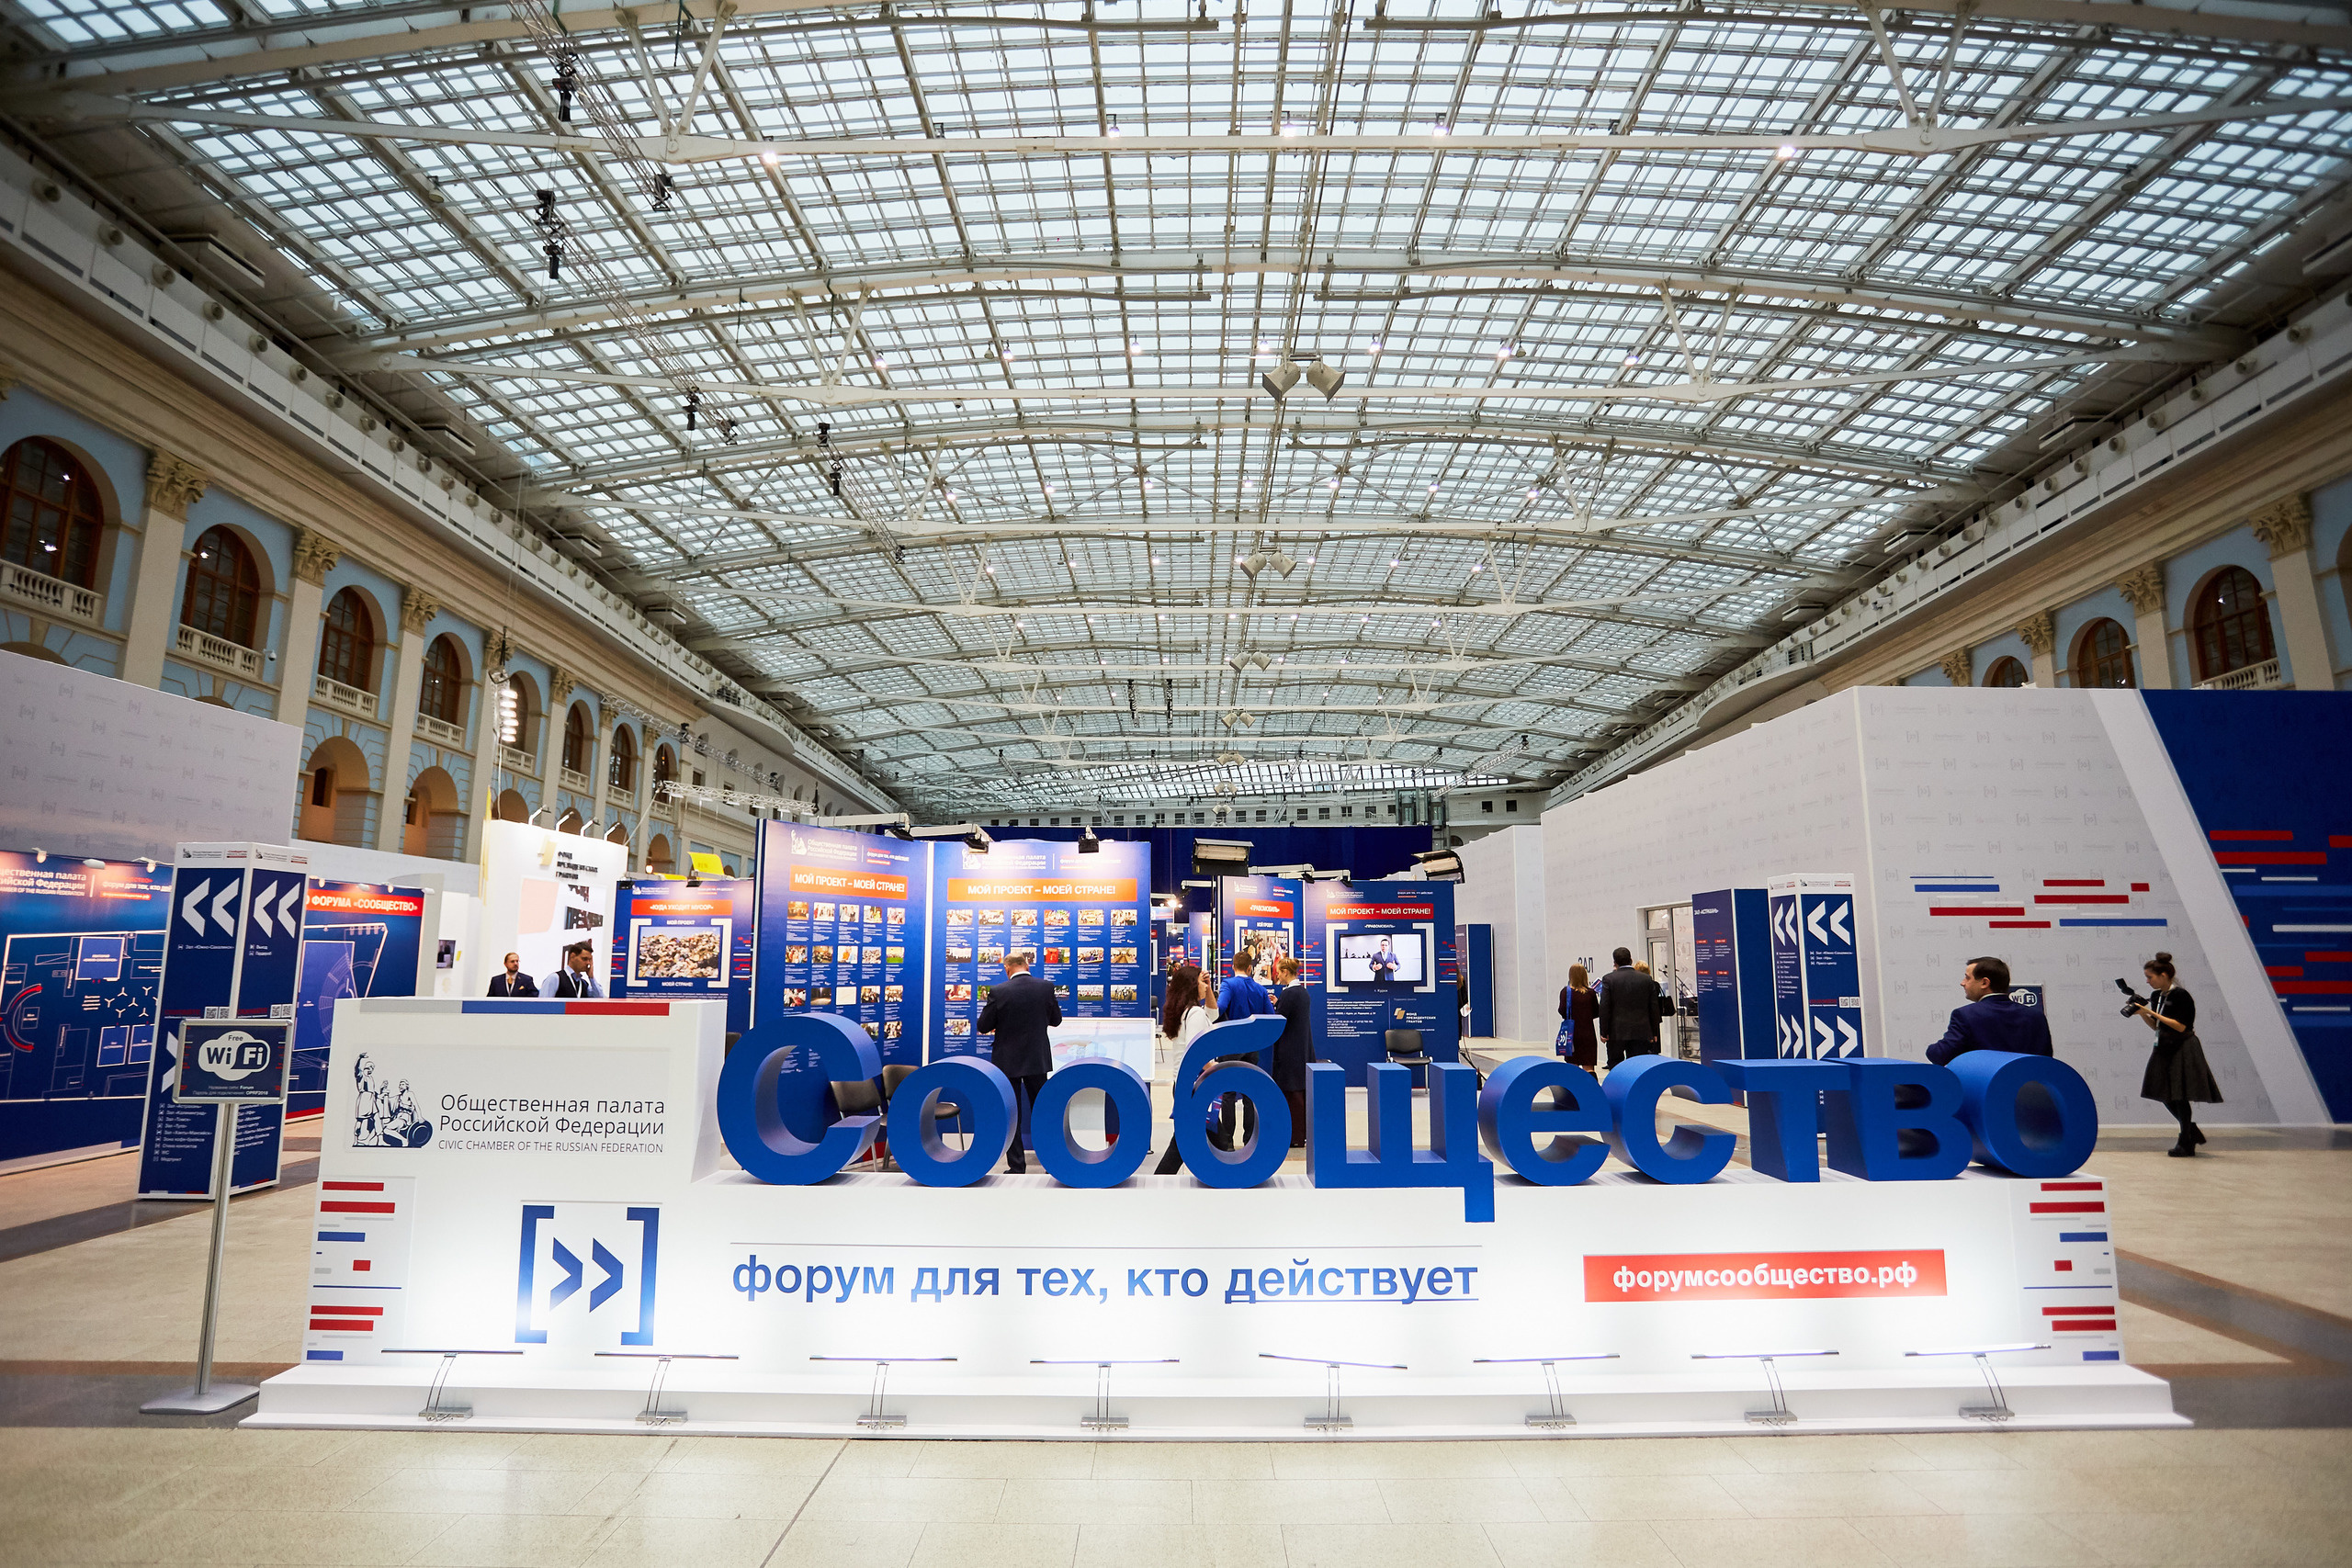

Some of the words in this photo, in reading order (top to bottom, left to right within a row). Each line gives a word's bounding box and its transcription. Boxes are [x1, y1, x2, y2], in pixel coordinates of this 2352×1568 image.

[36, 878, 85, 890] Федерации
[55, 873, 86, 881] палата
[795, 873, 814, 885] МОЙ
[816, 875, 847, 887] ПРОЕКТ
[854, 879, 875, 889] МОЕЙ
[876, 881, 905, 892] СТРАНЕ!
[968, 884, 991, 895] МОЙ
[993, 886, 1034, 894] ПРОЕКТ
[1043, 884, 1071, 895] МОЕЙ
[1074, 886, 1115, 895] СТРАНЕ!
[311, 896, 351, 907] ФОРУМА
[353, 898, 418, 911] «СООБЩЕСТВО»
[441, 1094, 589, 1114] Общественная
[597, 1100, 664, 1113] палата
[439, 1115, 549, 1133] Российской
[555, 1117, 664, 1138] Федерации
[718, 1012, 2098, 1222] Сообщество
[438, 1139, 463, 1150] CIVIC
[466, 1140, 514, 1151] CHAMBER
[517, 1141, 531, 1151] OF
[534, 1141, 552, 1151] THE
[555, 1142, 598, 1152] RUSSIAN
[601, 1142, 663, 1153] FEDERATION
[733, 1255, 894, 1303] форум
[910, 1267, 1000, 1303] для
[1016, 1267, 1108, 1304] тех,
[1126, 1267, 1208, 1297] кто
[1224, 1258, 1479, 1304] действует
[1611, 1261, 1917, 1292] форумсообщество.рф
